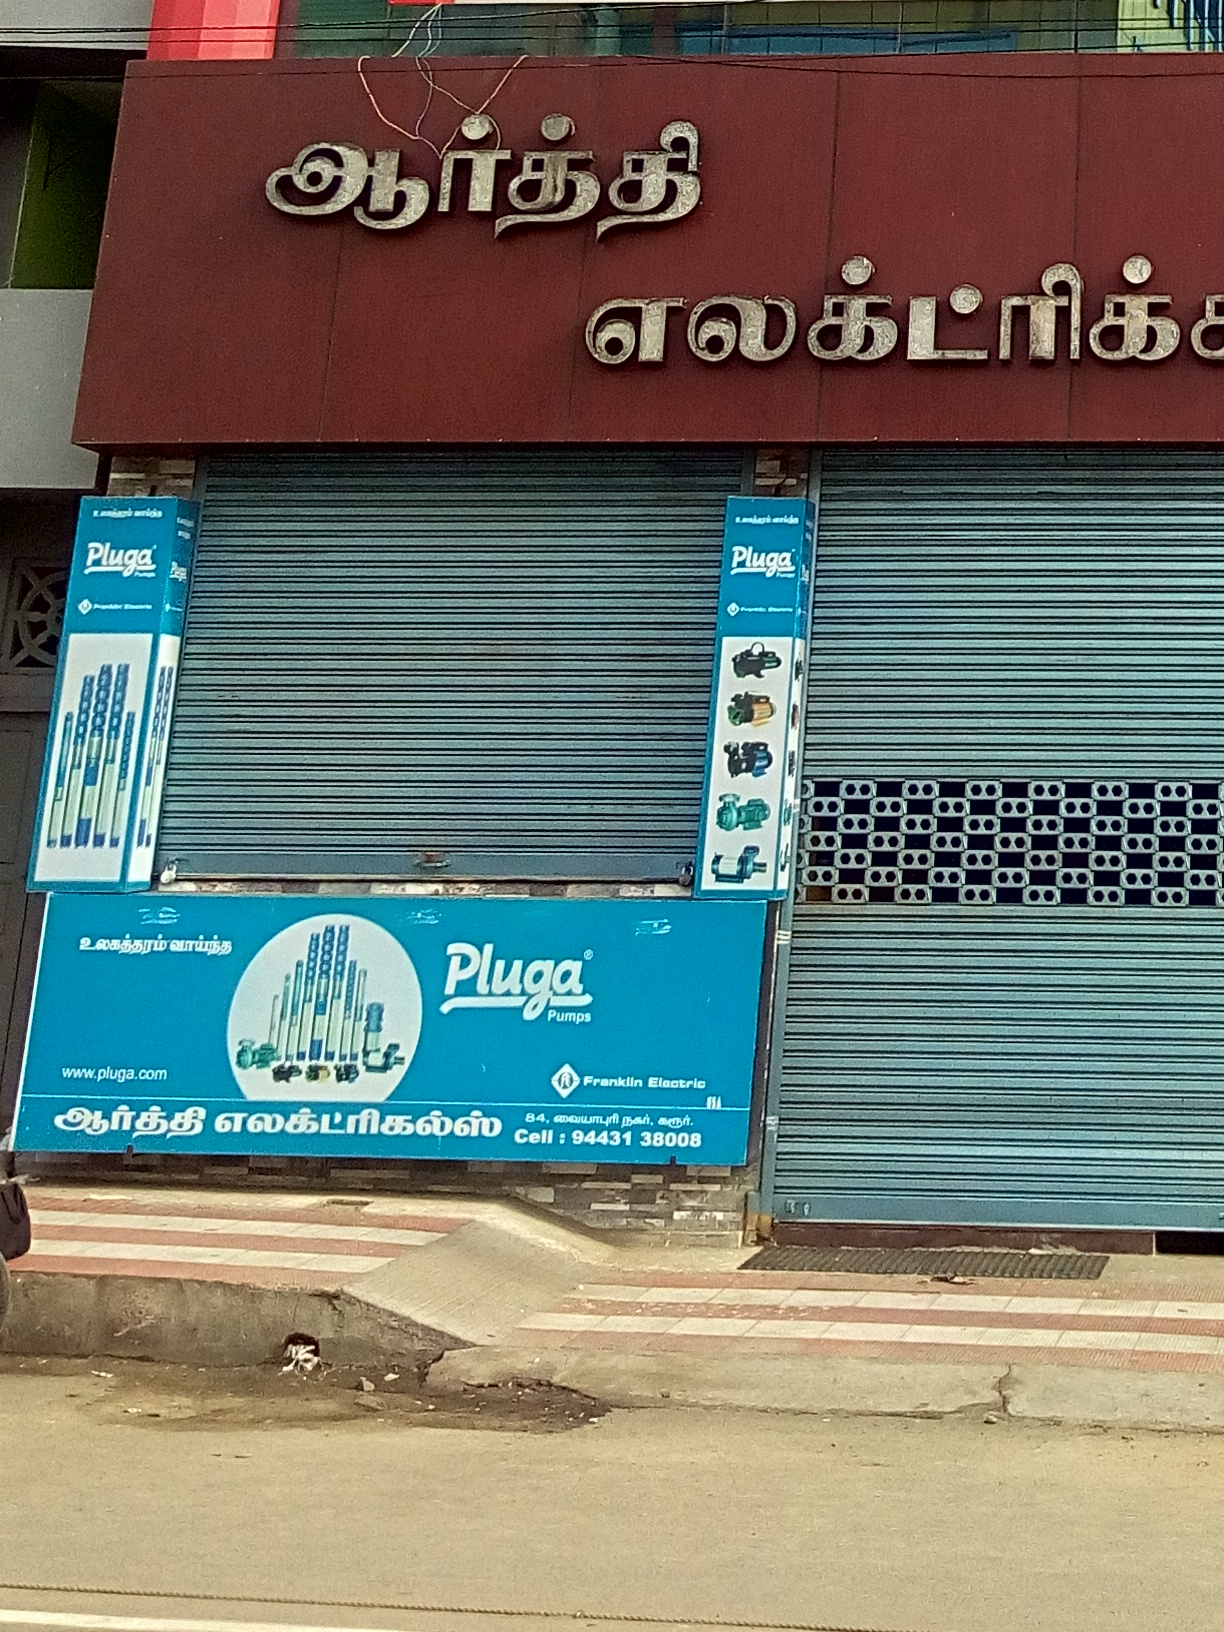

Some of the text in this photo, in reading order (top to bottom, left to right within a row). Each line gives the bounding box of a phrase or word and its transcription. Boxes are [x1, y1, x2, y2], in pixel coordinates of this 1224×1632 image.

[265, 112, 702, 242] ஆர்த்தி
[86, 542, 153, 577] Pluga
[732, 546, 792, 577] Pluga
[79, 933, 167, 955] உலகத்தரம்
[443, 942, 584, 1020] Pluga
[547, 1009, 592, 1024] Pumps
[62, 1066, 168, 1082] www.pluga.com
[583, 1075, 706, 1089] Franklin Electric
[55, 1104, 502, 1139] ஆர்த்தி எலக்ட்ரிகல்ஸ்
[514, 1129, 553, 1144] Cell
[572, 1130, 632, 1146] 94431
[640, 1132, 702, 1147] 38008
